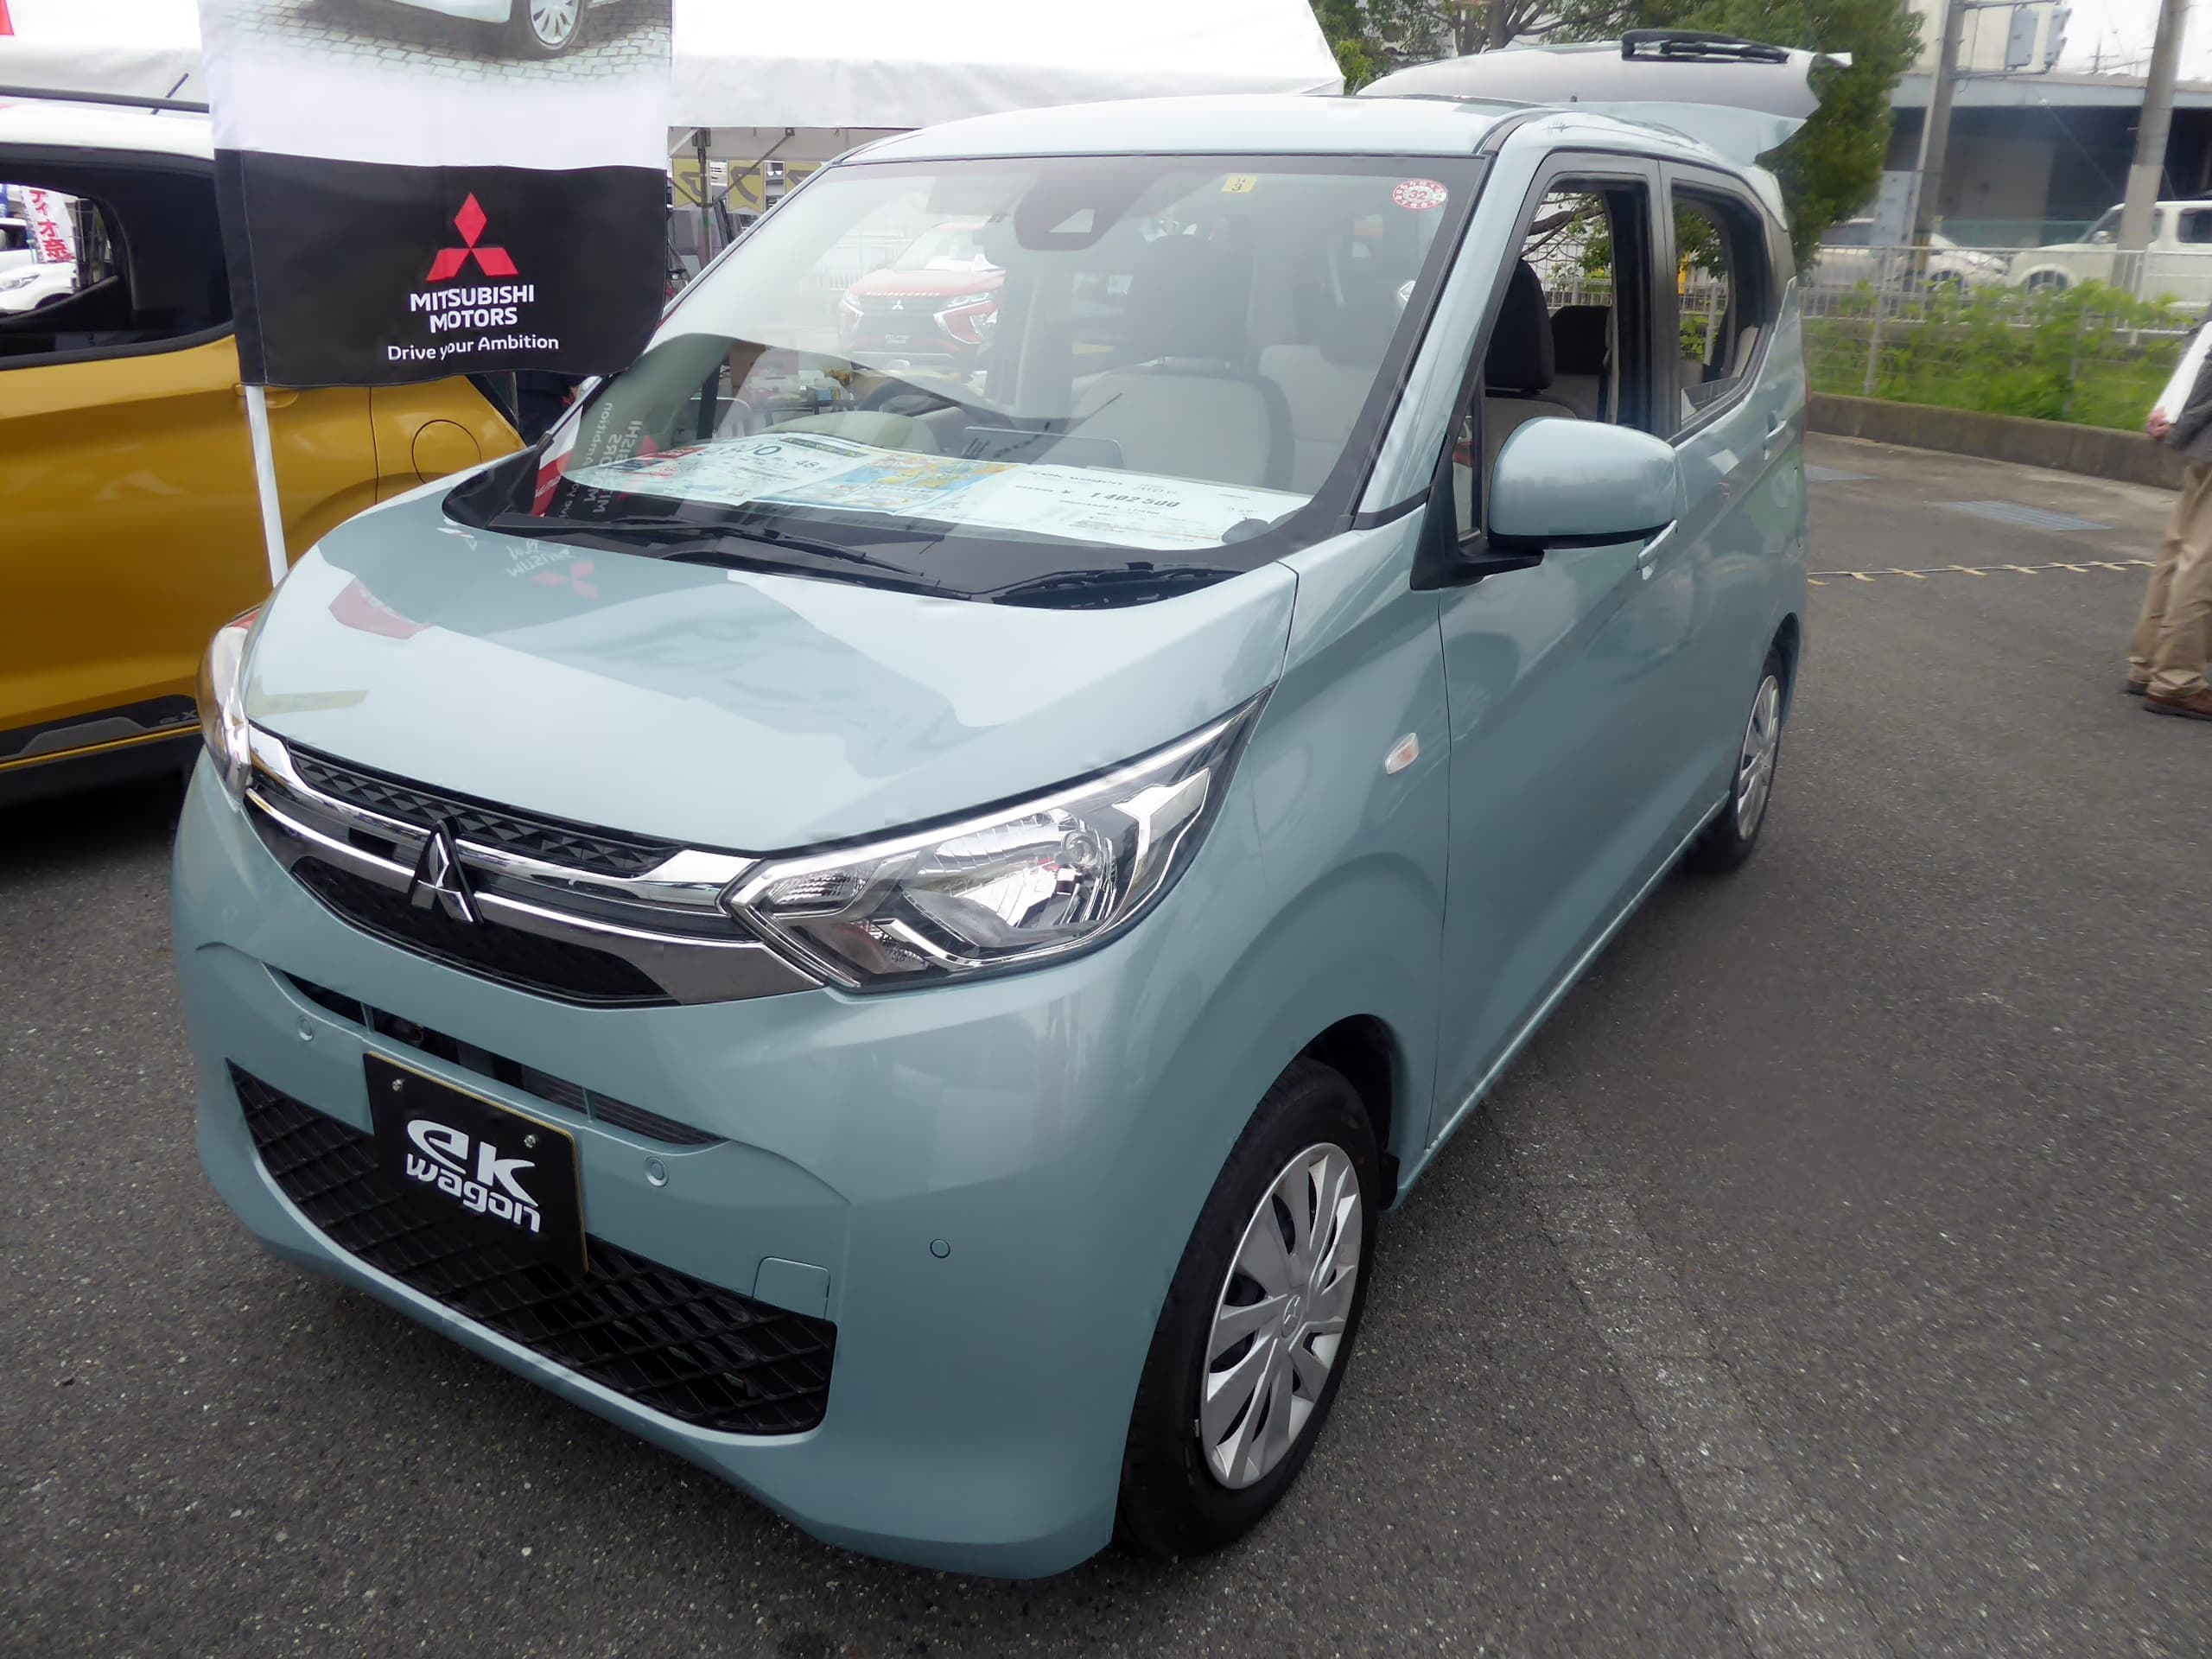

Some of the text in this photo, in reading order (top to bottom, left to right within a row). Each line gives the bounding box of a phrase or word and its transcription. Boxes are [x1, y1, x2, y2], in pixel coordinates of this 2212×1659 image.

[1409, 190, 1427, 200] 32
[410, 284, 535, 312] MITSUBISHI
[429, 307, 518, 333] MOTORS
[388, 334, 559, 360] Drive your Ambition
[406, 1153, 542, 1234] wagon
